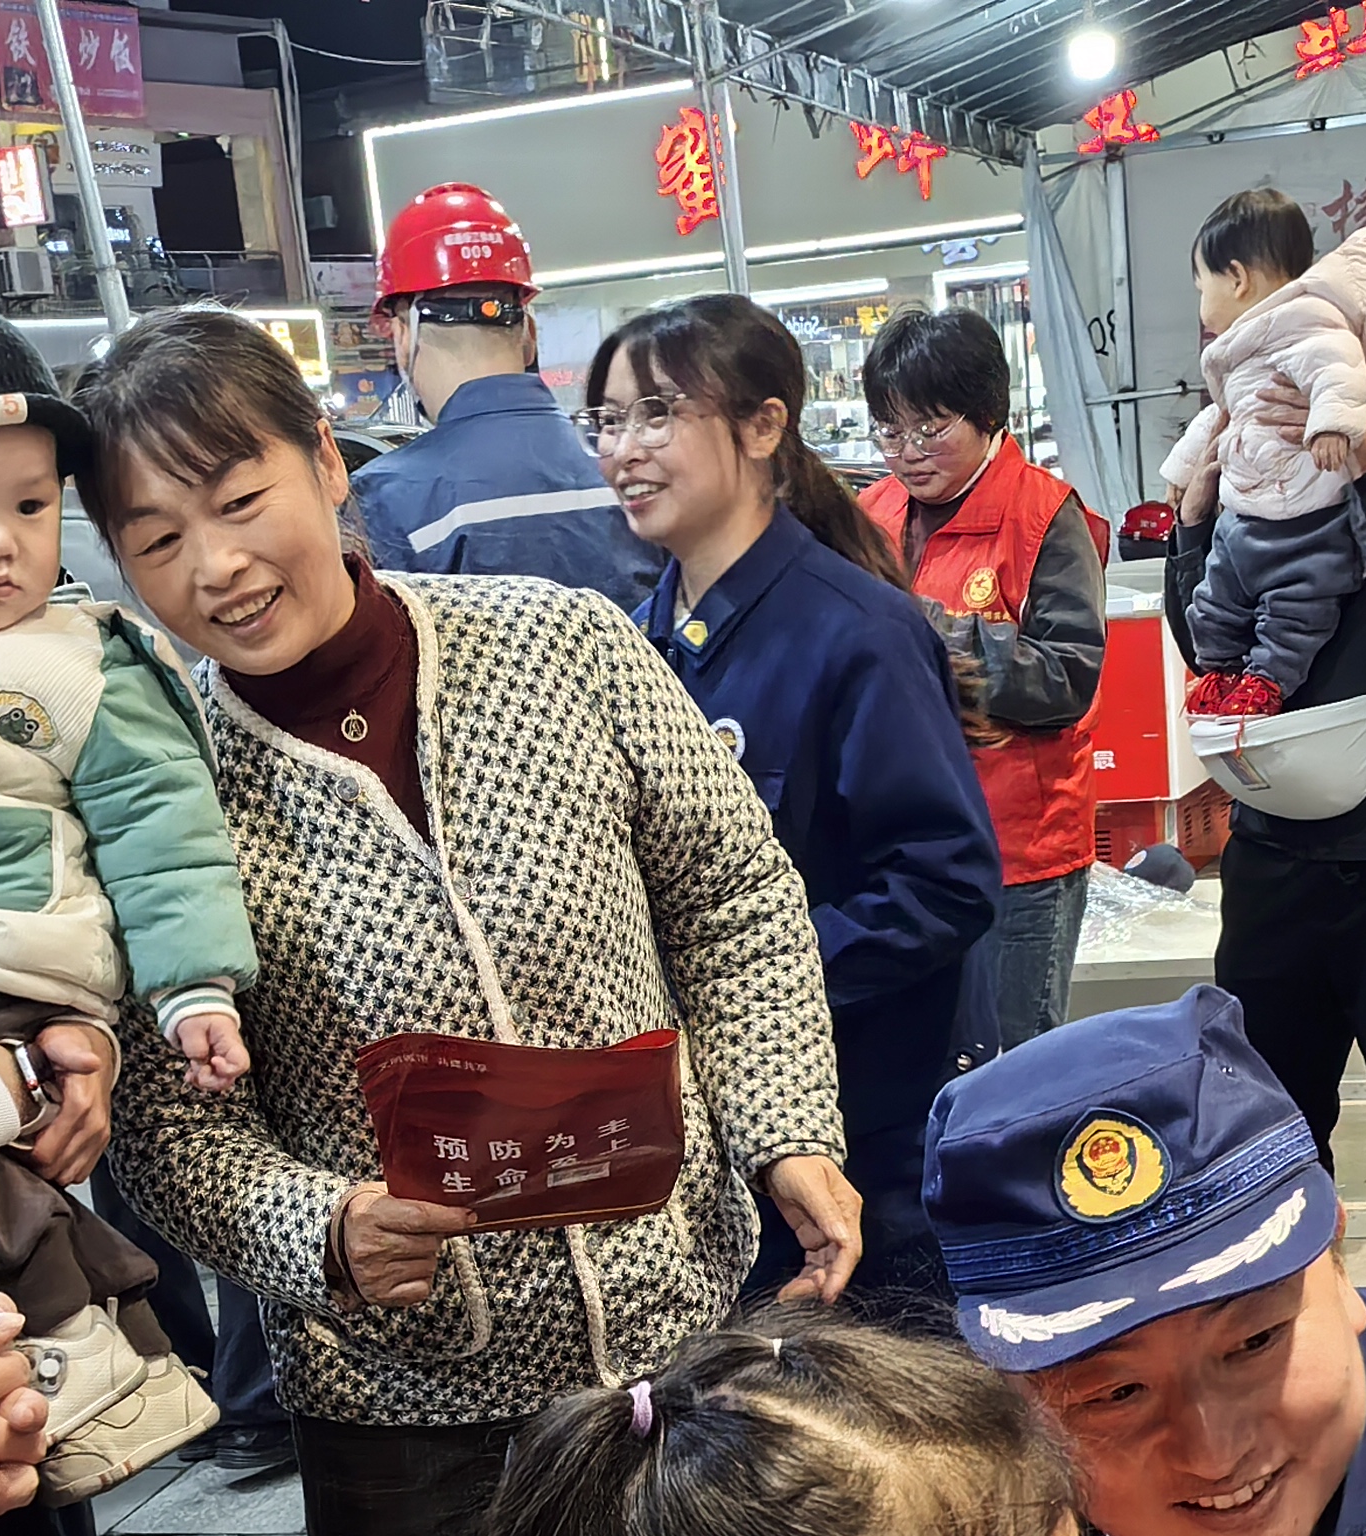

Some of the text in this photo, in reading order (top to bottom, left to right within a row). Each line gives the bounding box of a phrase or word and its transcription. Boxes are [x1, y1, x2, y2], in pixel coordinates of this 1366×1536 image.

[4, 17, 135, 75] 铁炒饭
[461, 245, 492, 259] 009
[433, 1117, 630, 1162] 预防为主
